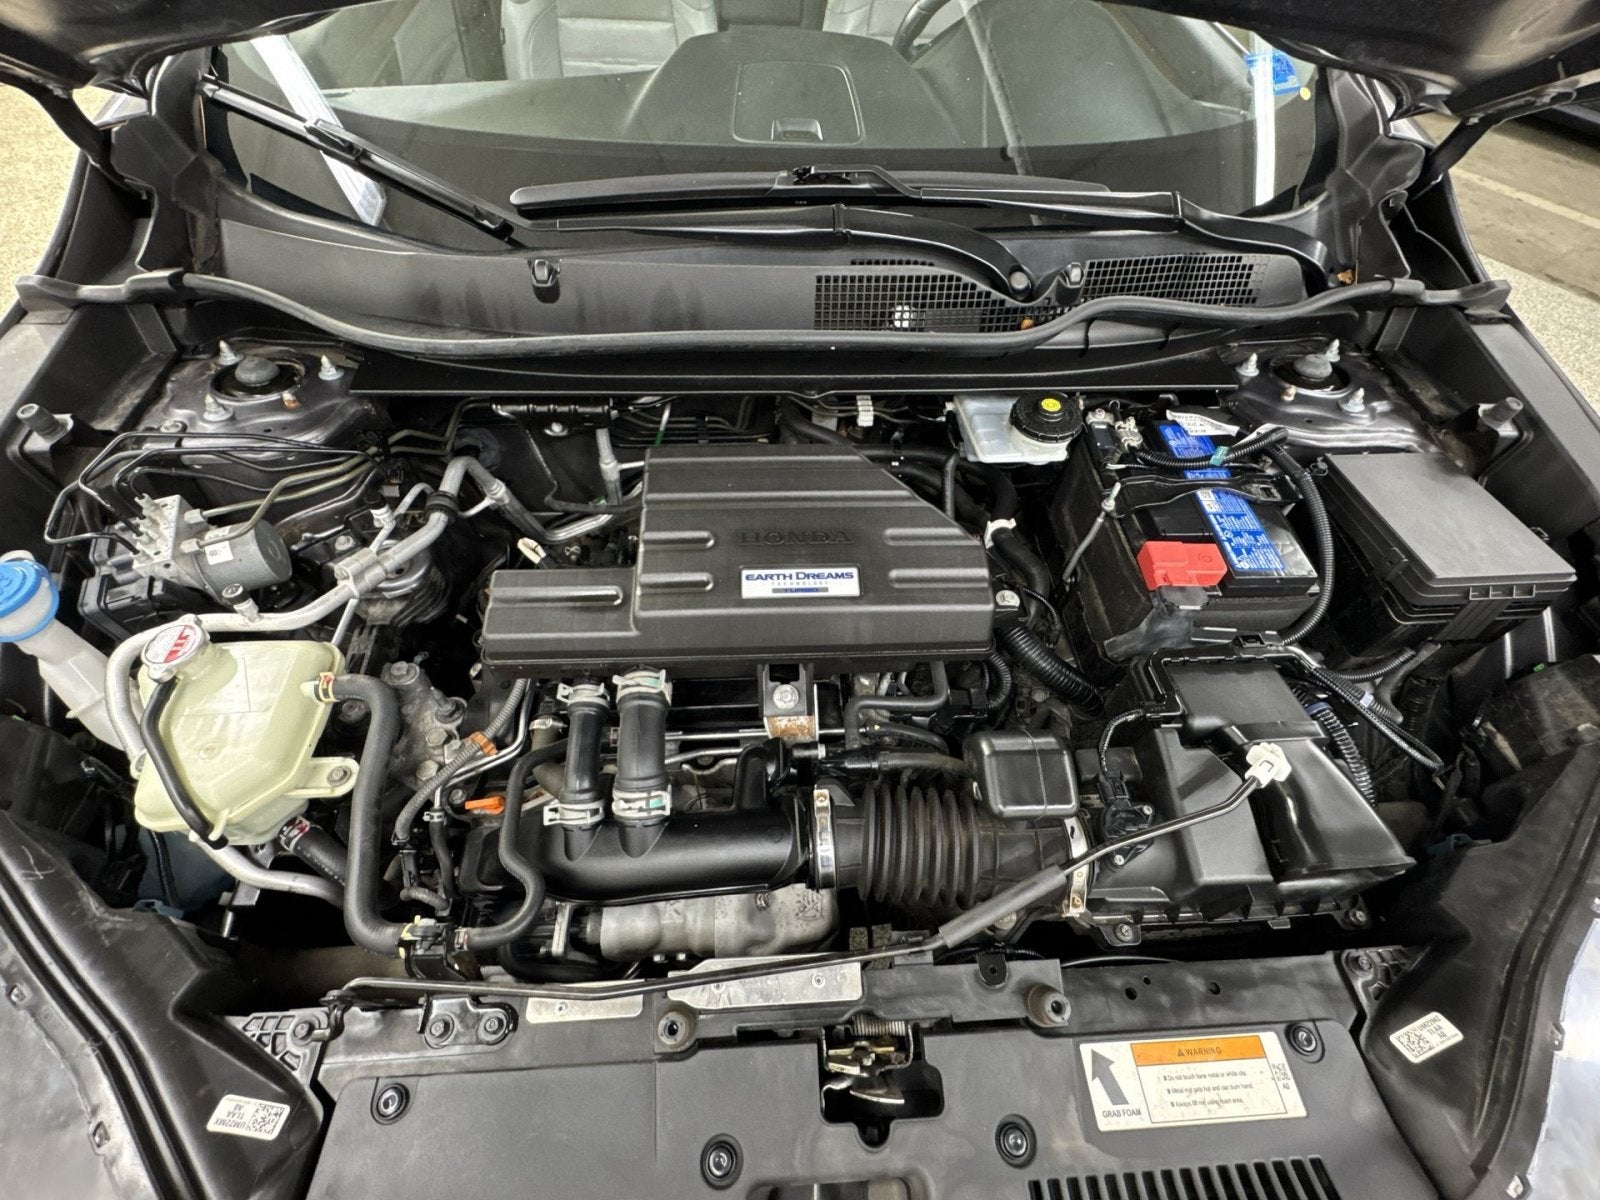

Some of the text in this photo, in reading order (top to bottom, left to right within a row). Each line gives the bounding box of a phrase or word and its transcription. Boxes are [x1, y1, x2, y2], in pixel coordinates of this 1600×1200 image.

[739, 531, 855, 546] HONDA
[745, 572, 854, 581] EARTH DREAMS
[1184, 1046, 1222, 1056] WARNING
[1102, 1108, 1142, 1118] GRAB FOAM
